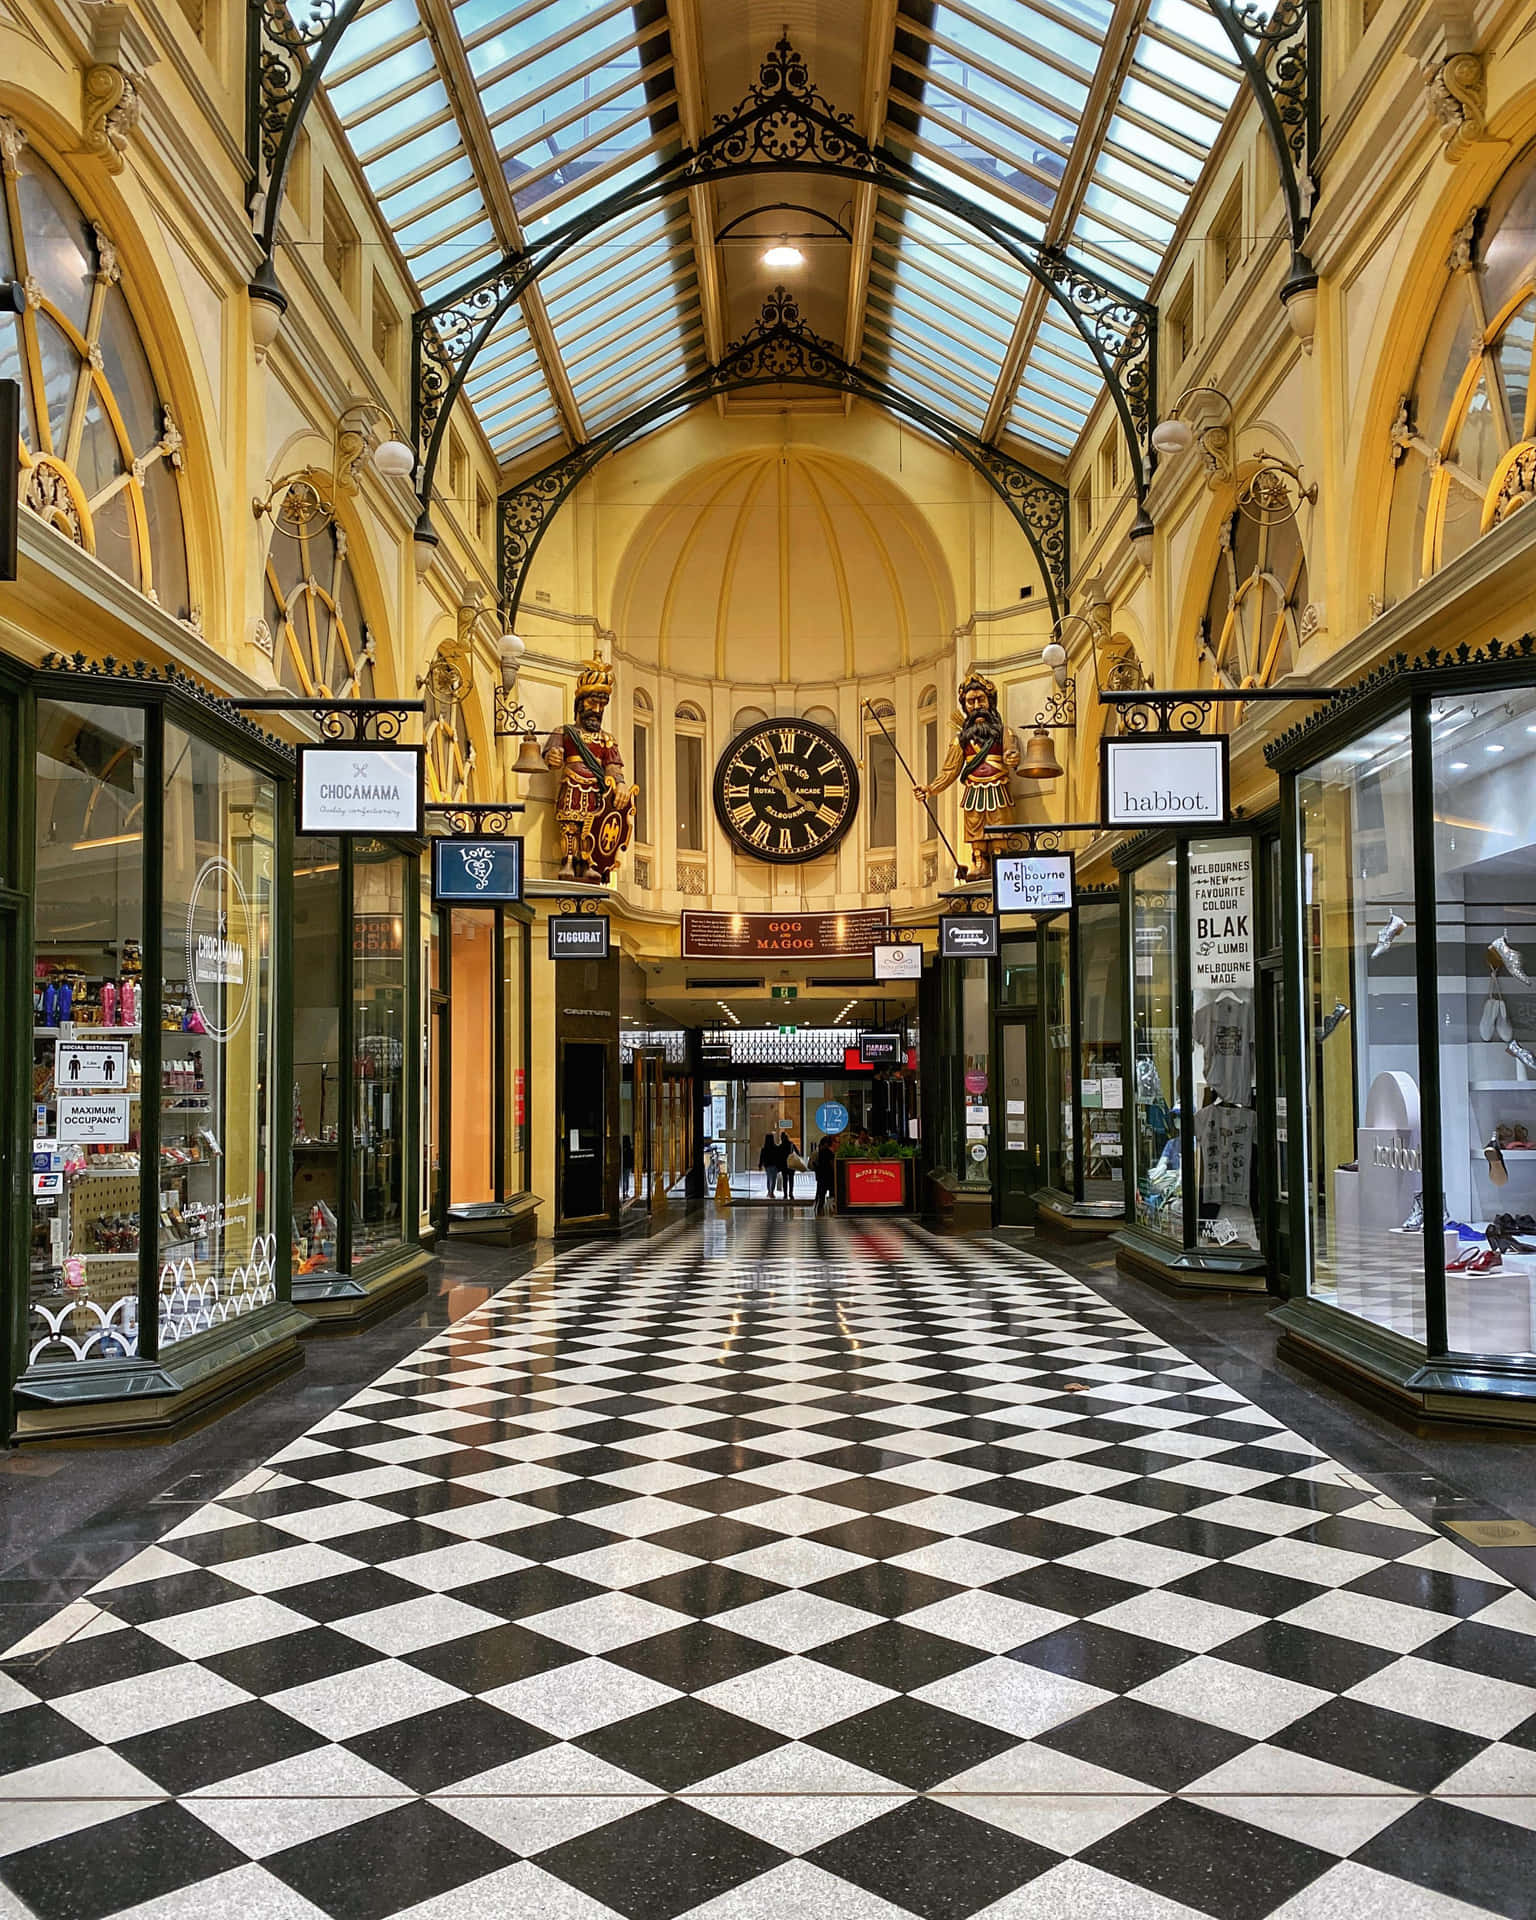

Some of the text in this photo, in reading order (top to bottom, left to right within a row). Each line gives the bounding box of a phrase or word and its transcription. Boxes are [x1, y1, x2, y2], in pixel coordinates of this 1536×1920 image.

[778, 733, 796, 754] XII
[734, 758, 757, 777] X
[817, 759, 840, 776] II
[320, 784, 400, 800] CHOCAMAMA
[729, 784, 750, 798] IX
[824, 785, 845, 797] III
[780, 828, 793, 849] VI
[1013, 861, 1034, 872] The
[1190, 861, 1250, 875] MELBOURNES
[1003, 868, 1065, 881] Melbourne
[1210, 875, 1229, 886] NEW
[1014, 881, 1043, 894] Shop
[1195, 886, 1246, 900] FAVOURITE
[1025, 889, 1040, 904] by
[1202, 899, 1238, 911] COLOUR
[768, 922, 802, 932] GOG
[1197, 915, 1249, 939] BLAK
[557, 932, 601, 943] ZIGGURAT
[757, 939, 815, 949] MAGOG
[1217, 942, 1248, 954] LUMBI
[1197, 962, 1251, 974] MELBOURNE
[1210, 974, 1237, 985] MADE
[71, 1106, 116, 1114] MAXIMUM
[64, 1116, 122, 1124] OCCUPANCY
